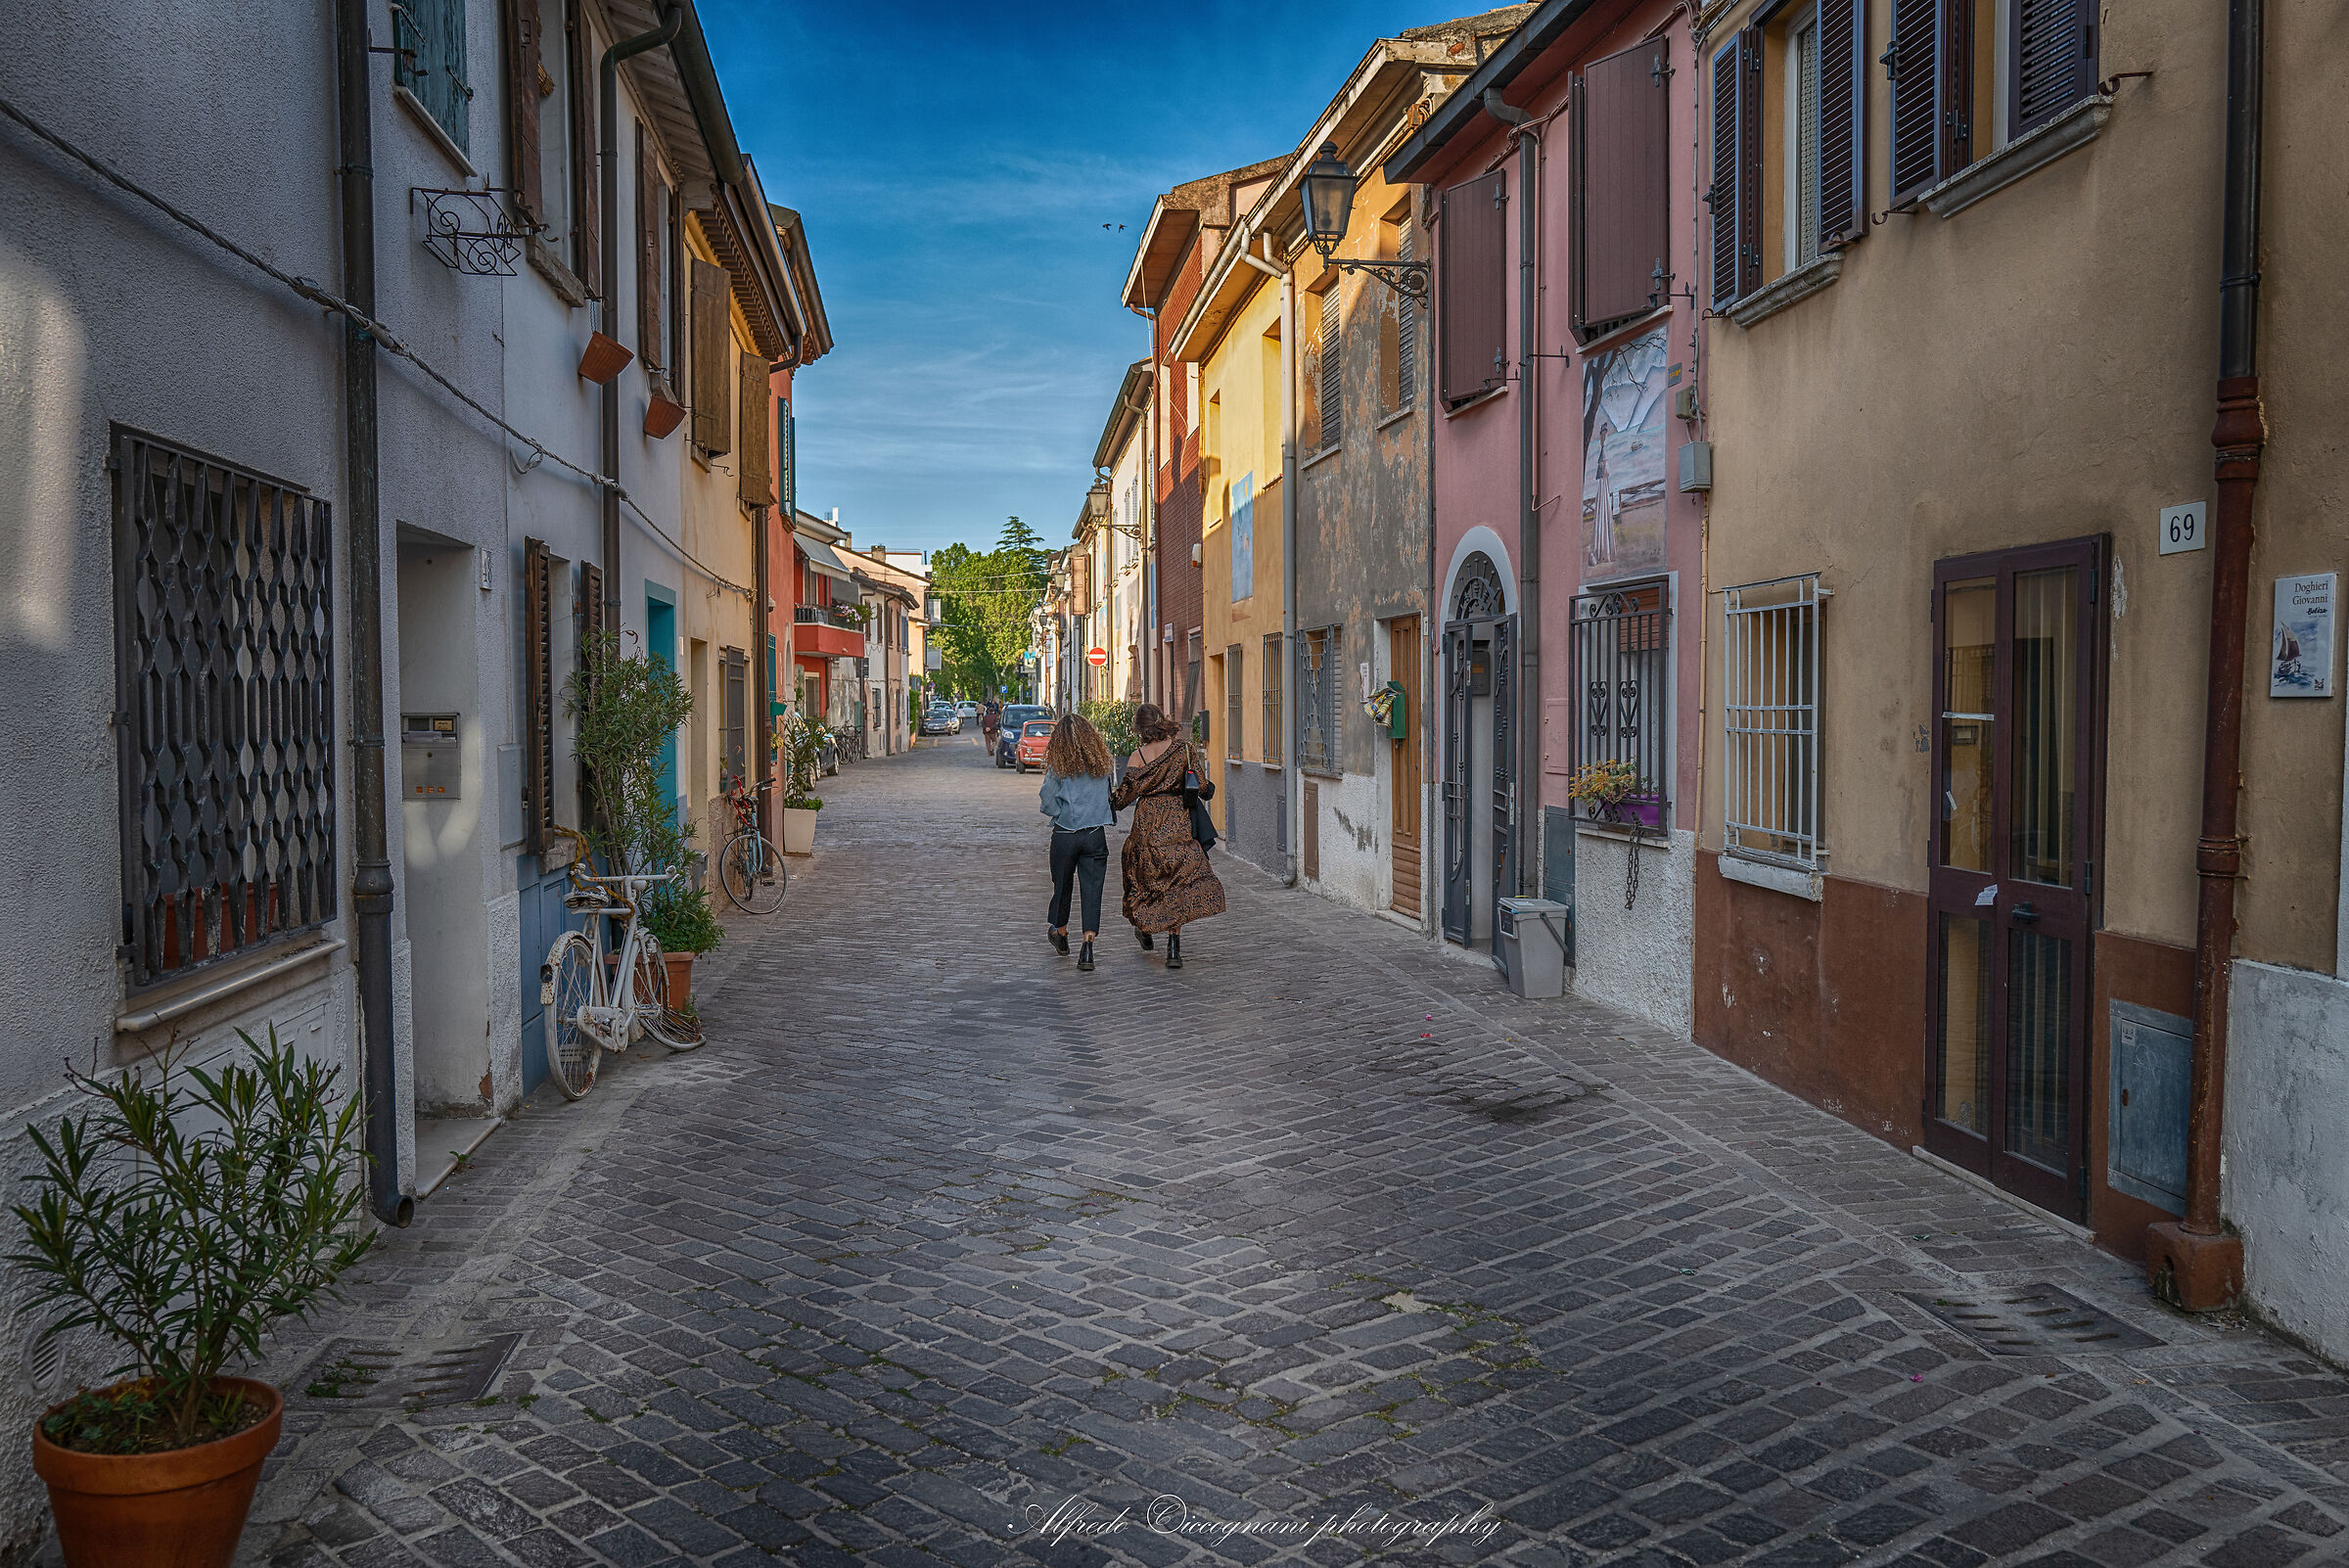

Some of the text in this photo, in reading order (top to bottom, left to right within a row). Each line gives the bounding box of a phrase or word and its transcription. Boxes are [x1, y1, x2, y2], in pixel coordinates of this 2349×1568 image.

[2170, 513, 2194, 542] 69
[2294, 580, 2328, 594] Doghieri
[2292, 593, 2328, 605] Giovanni
